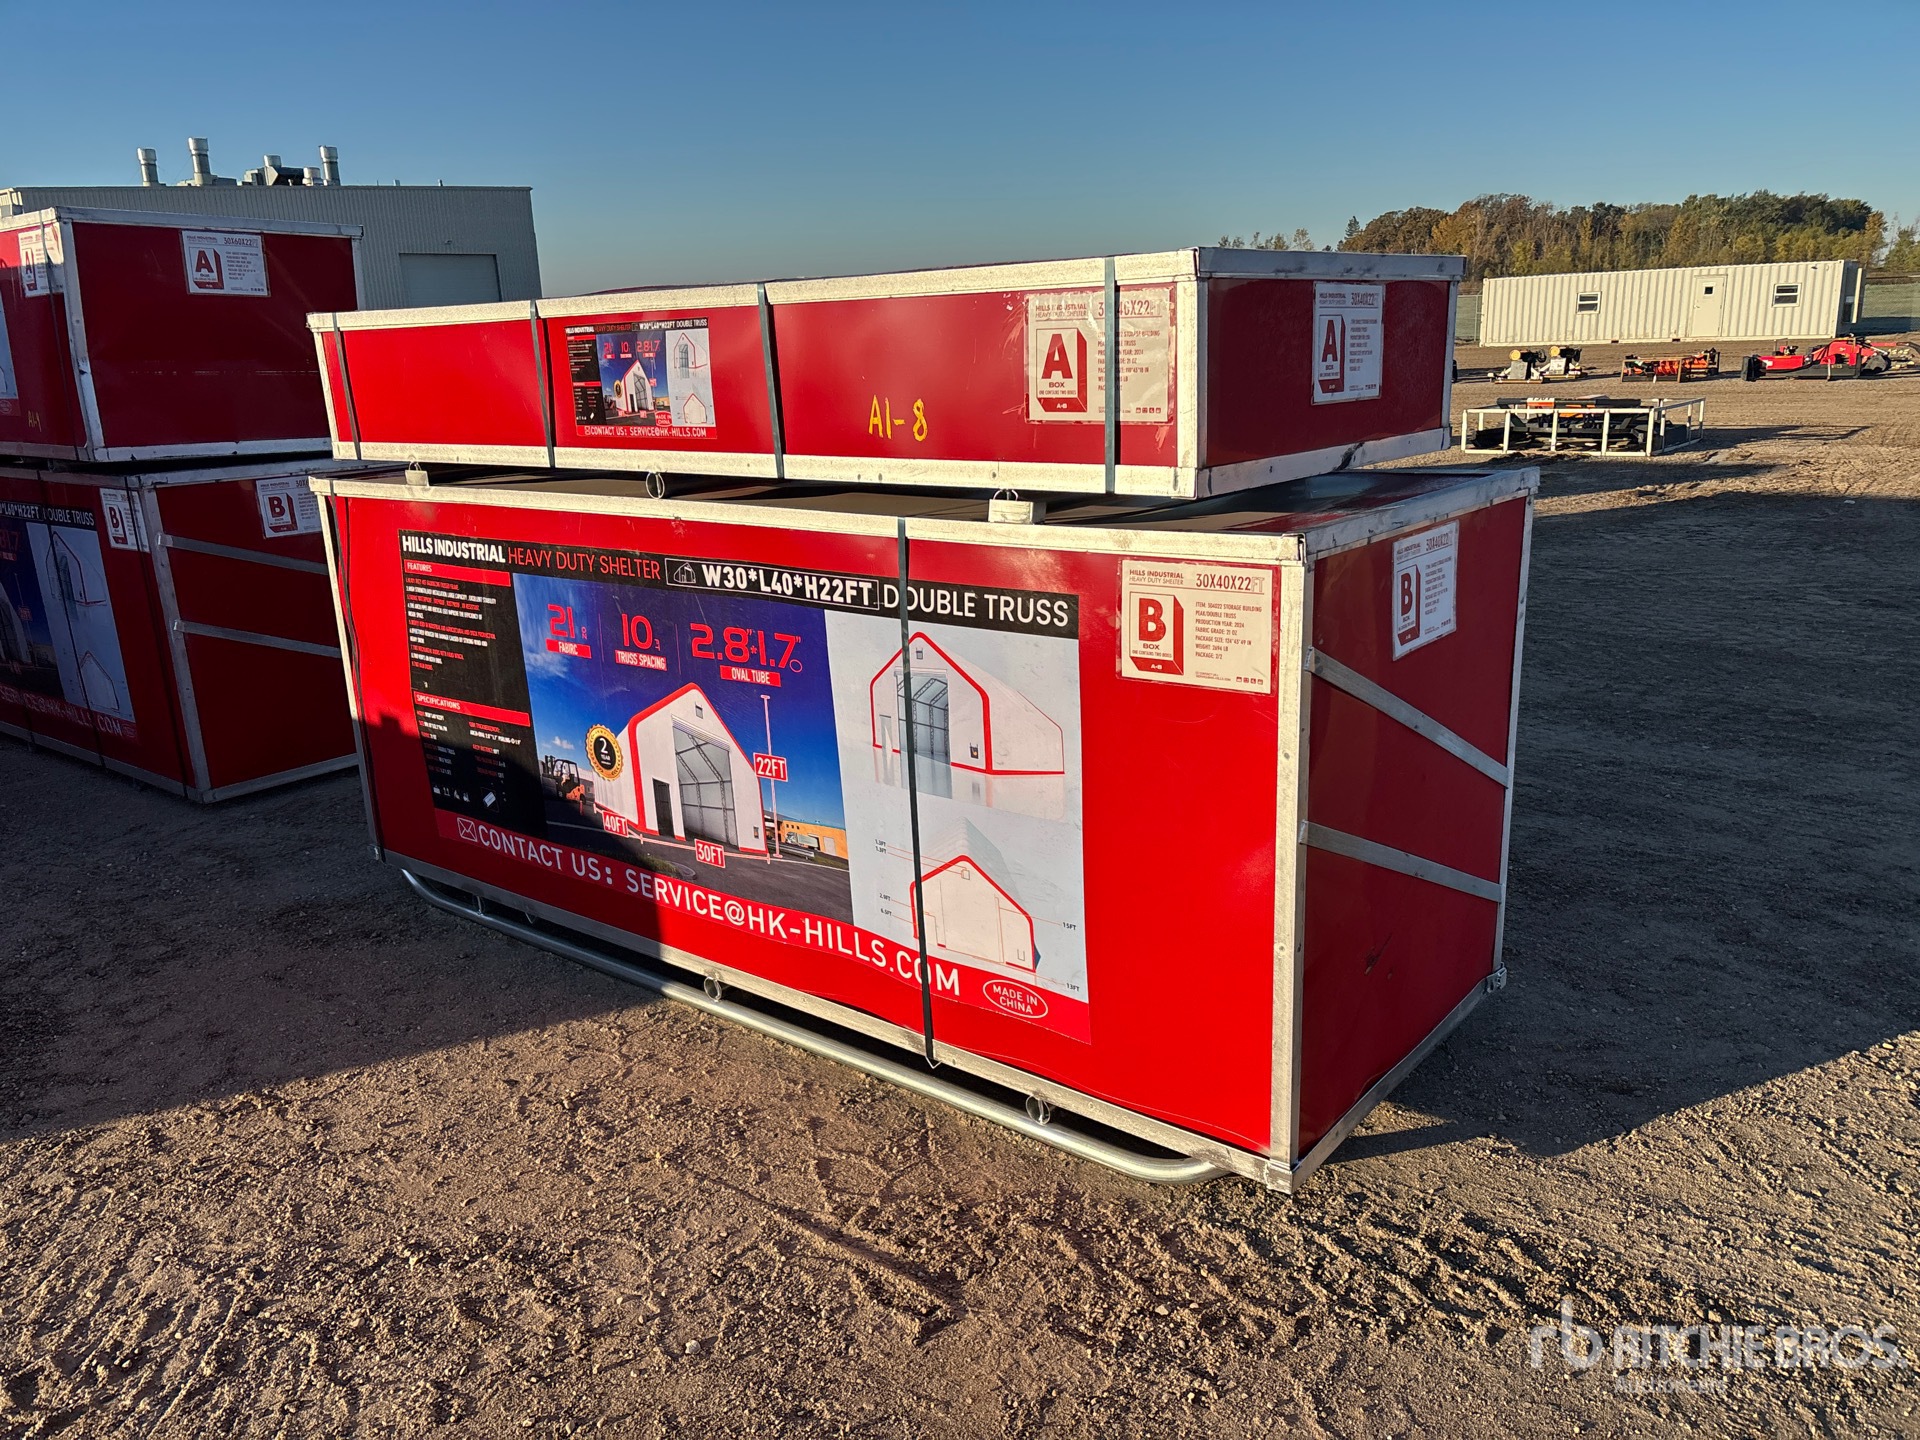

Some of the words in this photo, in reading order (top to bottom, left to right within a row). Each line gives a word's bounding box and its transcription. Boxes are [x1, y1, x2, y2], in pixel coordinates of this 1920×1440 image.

[196, 250, 214, 273] A
[676, 320, 692, 328] DOUBLE
[694, 318, 708, 327] TRUSS
[1322, 320, 1338, 362] A
[1042, 334, 1073, 379] A
[590, 426, 614, 436] CONTACT
[616, 427, 628, 436] US:
[630, 427, 707, 438] SERVICE@HK-HILLS.COM
[109, 506, 120, 529] B
[268, 496, 286, 518] B
[407, 562, 433, 573] FEATURES
[1147, 570, 1184, 579] INDUSTRIAL
[402, 536, 432, 554] HILLS
[434, 539, 506, 564] INDUSTRIAL
[508, 546, 552, 568] HEAVY
[556, 552, 596, 573] DUTY
[600, 556, 661, 580] SHELTER
[883, 584, 976, 618] DOUBLE
[984, 594, 1070, 628] TRUSS
[1400, 572, 1413, 616] B
[547, 604, 576, 638] 21
[1138, 598, 1166, 642] B
[1196, 626, 1210, 634] FABRIC
[622, 613, 653, 650] 10
[616, 651, 638, 664] TRUSS
[638, 654, 666, 670] SPACING
[731, 667, 750, 682] OVAL
[750, 669, 770, 684] TUBE
[416, 694, 461, 710] SPECIFICATIONS
[600, 737, 608, 754] 2
[756, 756, 786, 779] 22FT
[604, 812, 627, 836] 40FT
[478, 824, 562, 872] CONTACT
[570, 852, 613, 886] US:
[697, 843, 723, 865] 30FT
[992, 984, 1023, 1001] MADE
[1026, 994, 1038, 1006] IN
[1000, 996, 1033, 1014] CHINA
